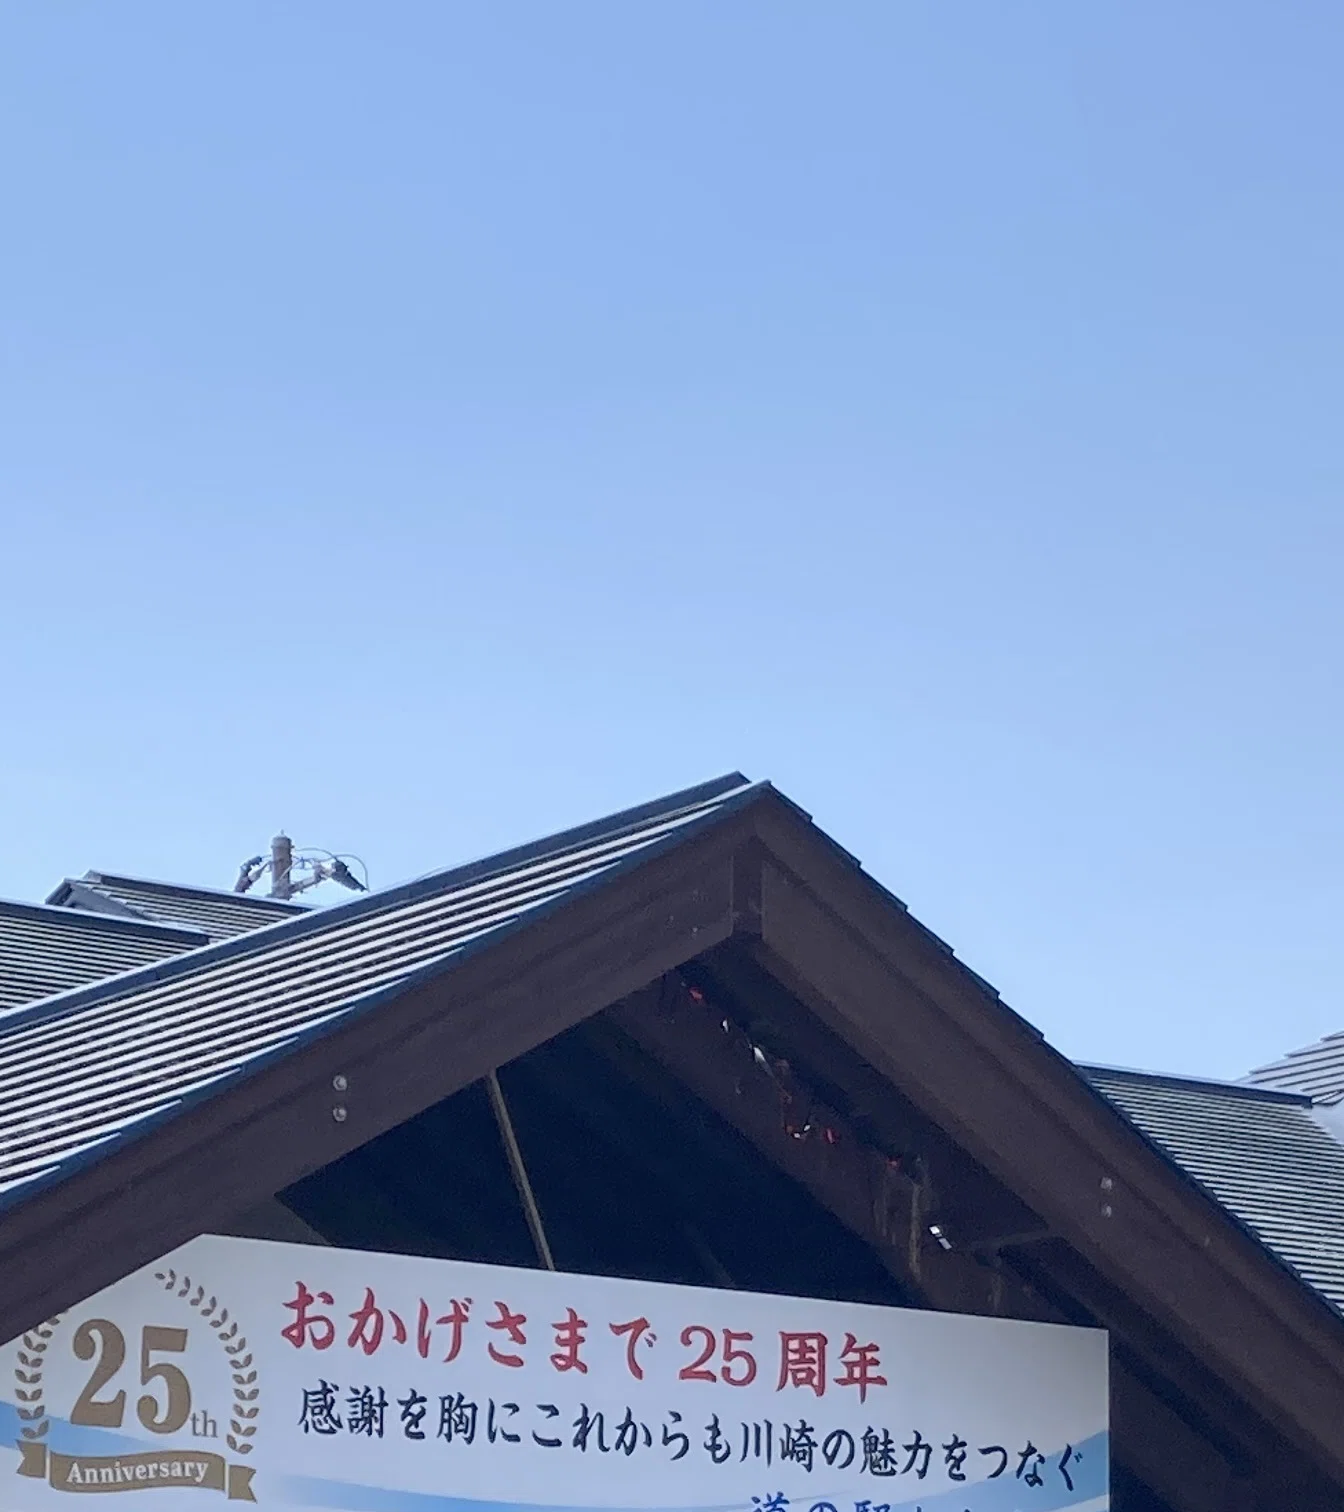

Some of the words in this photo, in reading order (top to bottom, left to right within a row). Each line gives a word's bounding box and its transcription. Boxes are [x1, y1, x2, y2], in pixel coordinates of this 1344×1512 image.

[297, 1378, 1083, 1491] 感謝を胸にこれからも川崎の魅力をつなぐ
[66, 1460, 209, 1484] Anniversary
